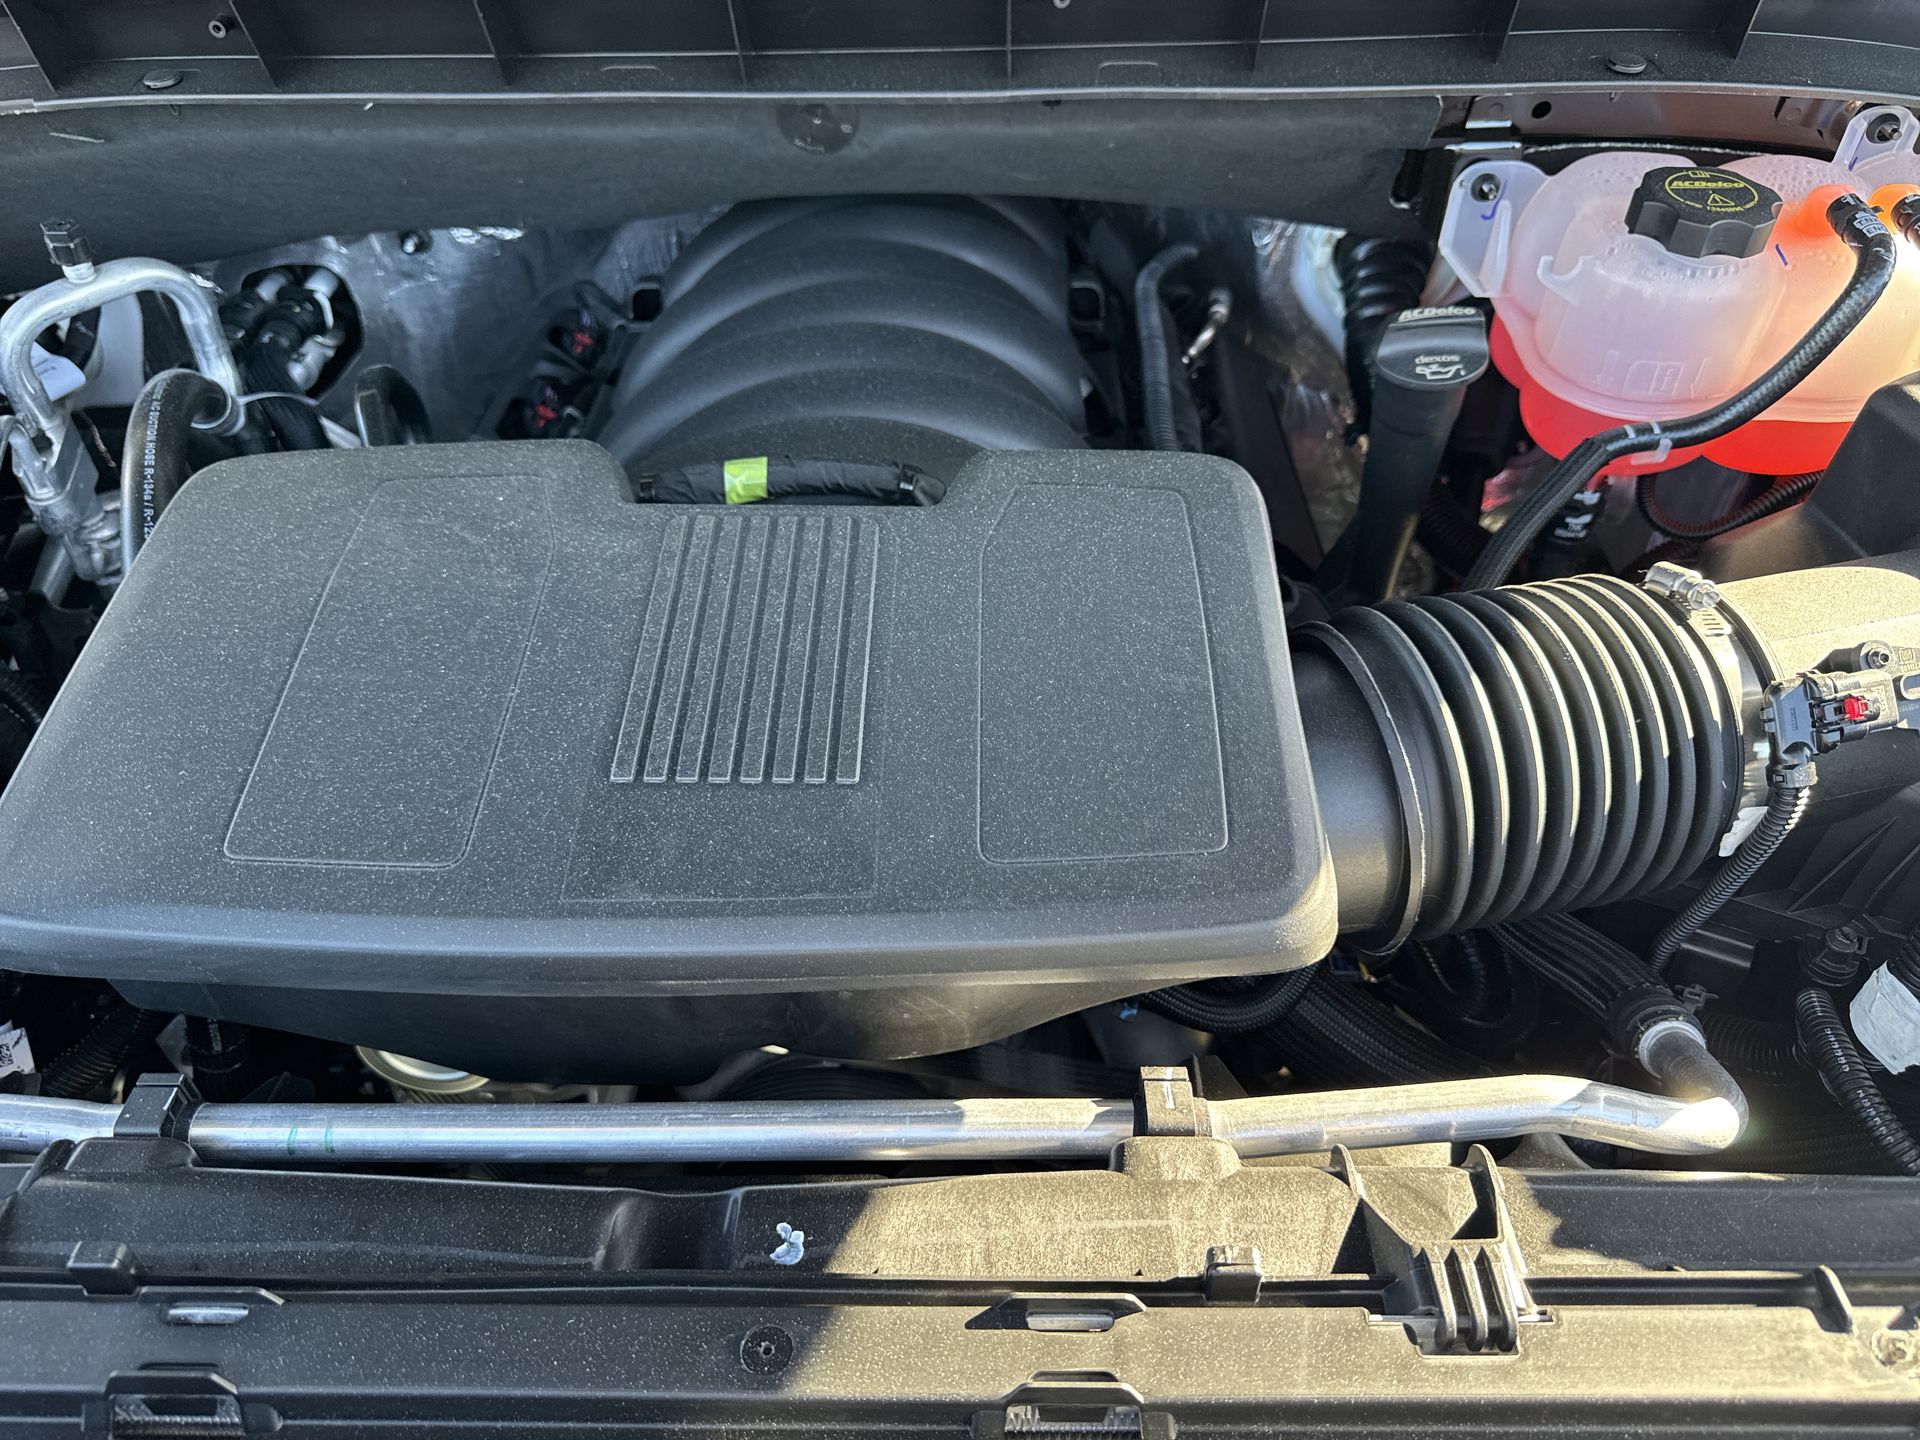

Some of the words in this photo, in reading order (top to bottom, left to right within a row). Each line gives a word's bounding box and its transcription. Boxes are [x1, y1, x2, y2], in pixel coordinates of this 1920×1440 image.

[1669, 180, 1745, 189] ACDelco
[1398, 306, 1477, 323] ACDelco
[1414, 354, 1461, 364] dexos
[146, 411, 160, 441] SUCTION
[144, 443, 156, 466] HOSE
[143, 468, 155, 501] R-134a
